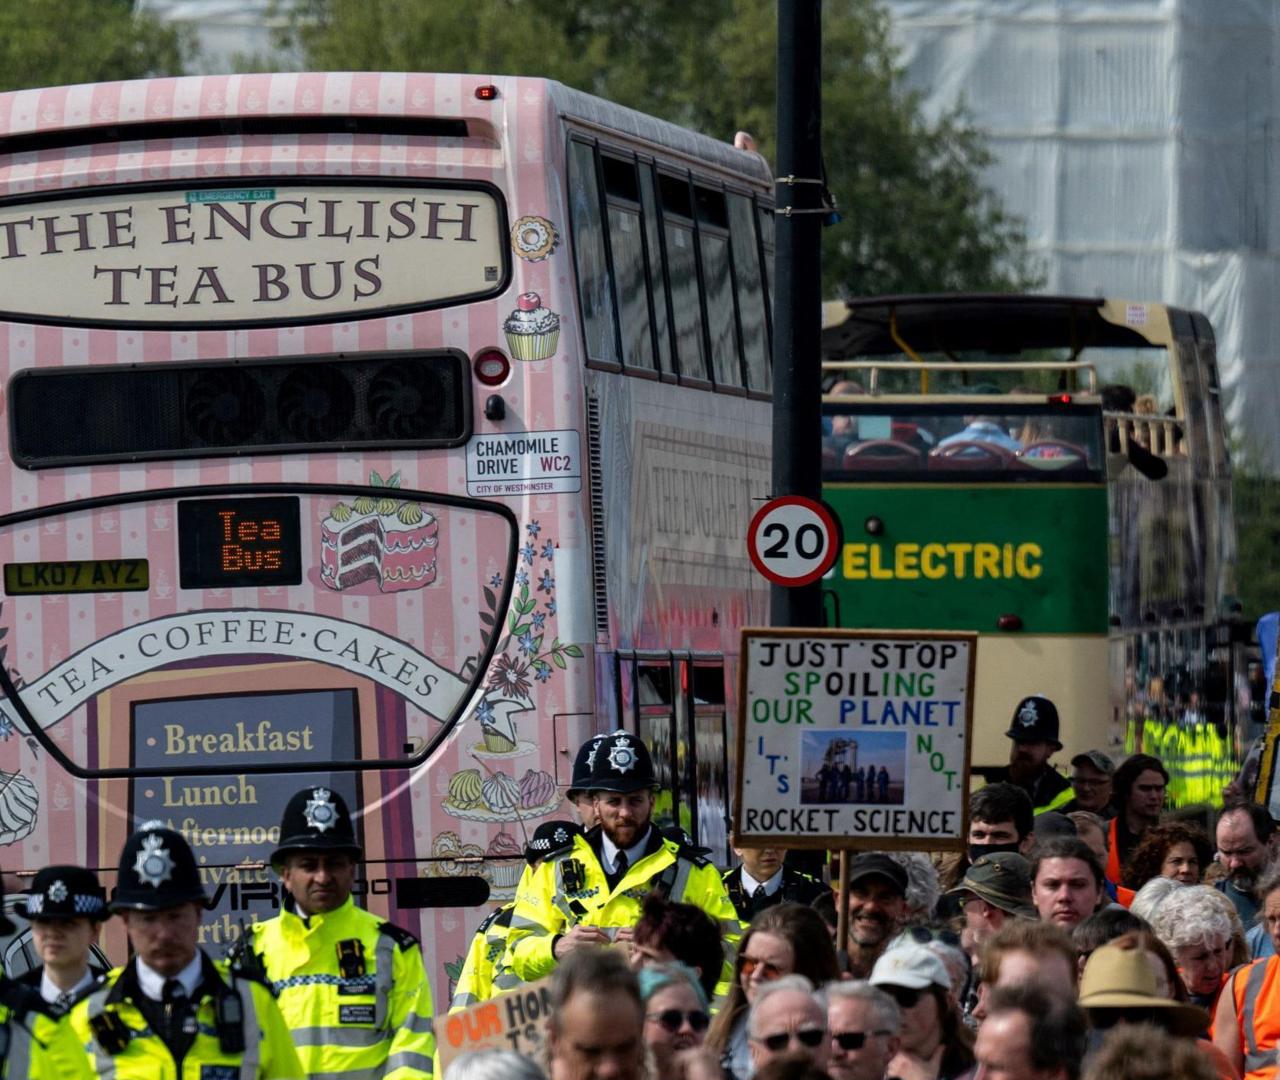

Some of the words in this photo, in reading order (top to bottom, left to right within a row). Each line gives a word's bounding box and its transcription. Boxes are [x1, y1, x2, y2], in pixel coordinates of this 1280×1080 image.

[199, 190, 249, 200] EMERGENCY
[253, 190, 271, 199] EXIT
[158, 197, 480, 245] ENGLISH
[93, 264, 235, 308] TEA
[252, 254, 382, 303] BUS
[476, 437, 559, 457] CHAMOMILE
[476, 458, 519, 475] DRIVE
[540, 455, 571, 472] WC2
[476, 484, 492, 494] CITY
[493, 484, 503, 492] OF
[504, 482, 554, 492] WESTMINSTER
[218, 511, 281, 542] Tea
[762, 522, 825, 560] 20
[222, 544, 282, 572] Bus
[842, 542, 1042, 580] ELECTRIC
[16, 563, 82, 588] LK07
[91, 561, 140, 585] AYZ
[36, 655, 115, 709] TEA
[136, 619, 295, 658] COFFEE
[312, 628, 440, 698] CAKES
[758, 642, 850, 668] JUST
[871, 643, 958, 669] STOP
[784, 672, 935, 697] SPOILING
[752, 698, 815, 724] OUR
[839, 700, 961, 727] PLANET
[163, 720, 314, 755] Breakfast
[757, 736, 790, 794] IT'S
[916, 734, 958, 791] NOT
[162, 774, 258, 807] Lunch
[167, 817, 281, 847] fternoo
[746, 808, 840, 832] ROCKET
[853, 809, 956, 834] SCIENCE
[197, 856, 269, 884] ivate
[446, 1003, 502, 1048] OUR
